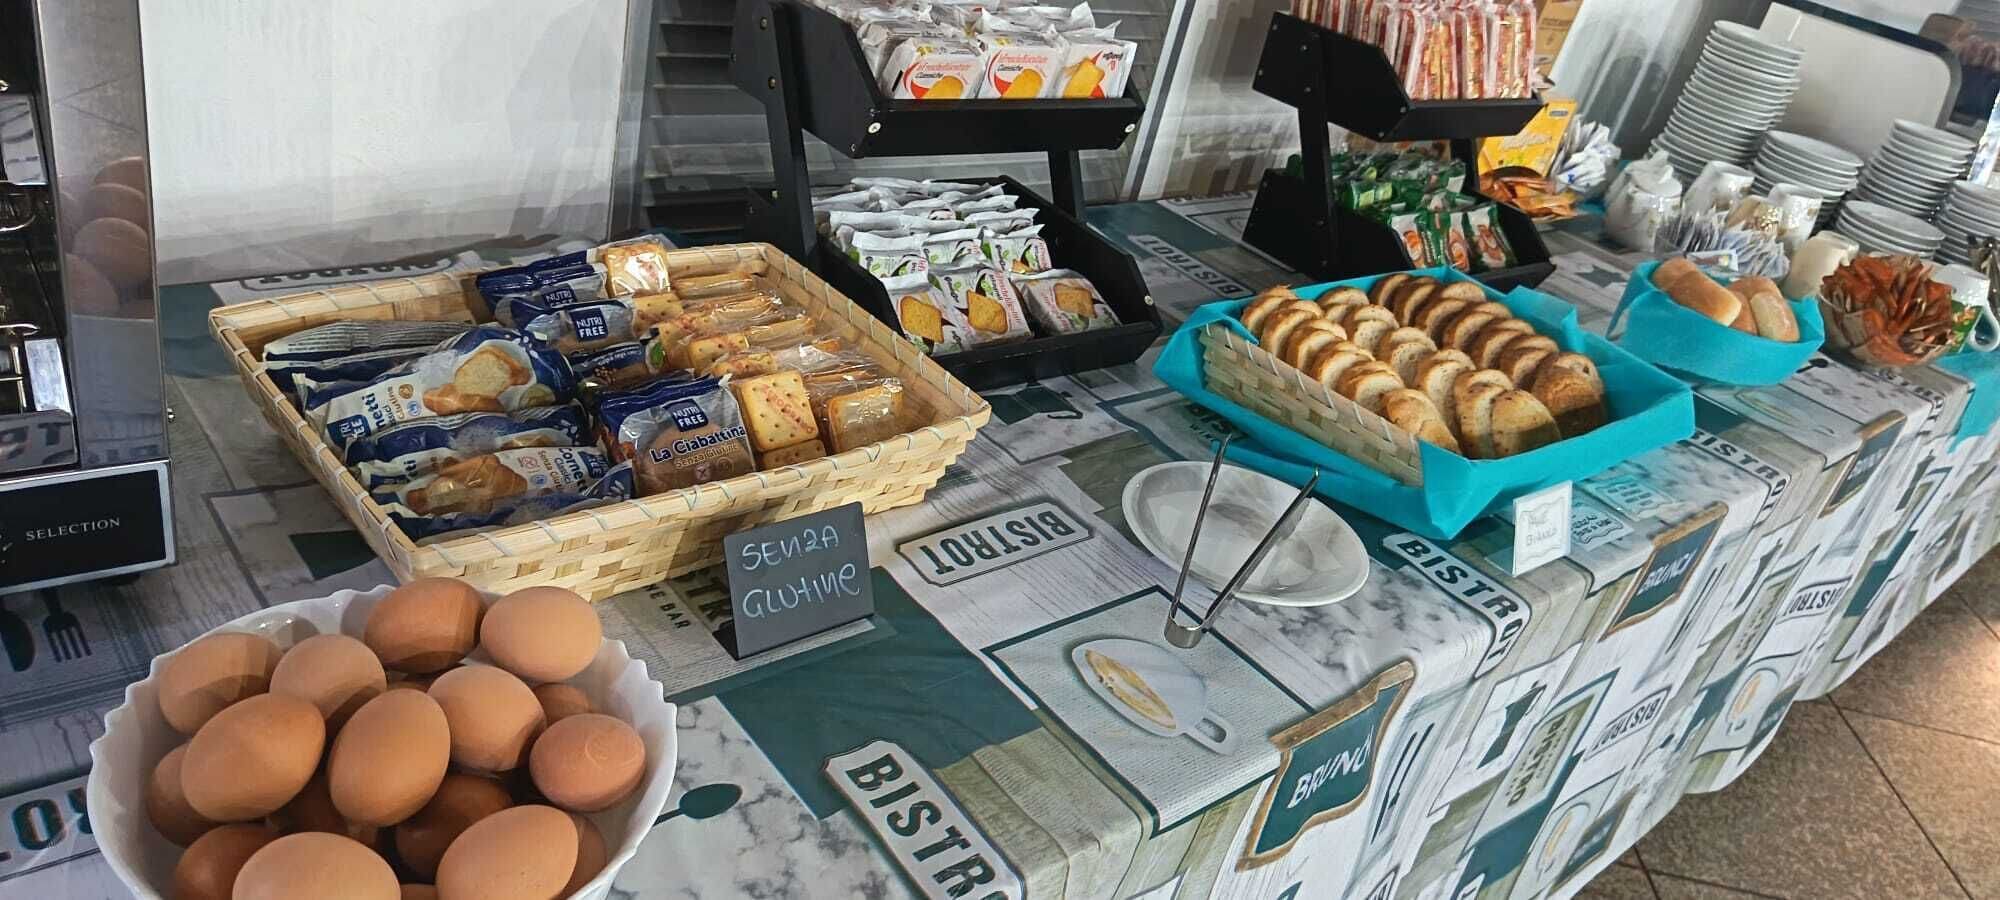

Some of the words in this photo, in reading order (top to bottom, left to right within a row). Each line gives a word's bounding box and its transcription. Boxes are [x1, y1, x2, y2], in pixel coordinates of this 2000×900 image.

[1137, 240, 1245, 294] BISTROT
[576, 315, 603, 328] NUTRI
[579, 325, 606, 339] FREE
[672, 406, 702, 419] NUTRI
[677, 414, 705, 428] FREE
[651, 448, 672, 464] La
[673, 425, 747, 455] Ciabattina
[675, 453, 704, 468] Senza
[704, 443, 739, 459] Glutine
[26, 517, 121, 541] SELECTION
[920, 510, 1076, 575] BISTROT
[1396, 539, 1523, 661] BISTROT
[659, 602, 692, 629] BAR
[846, 752, 1010, 900] BISTR
